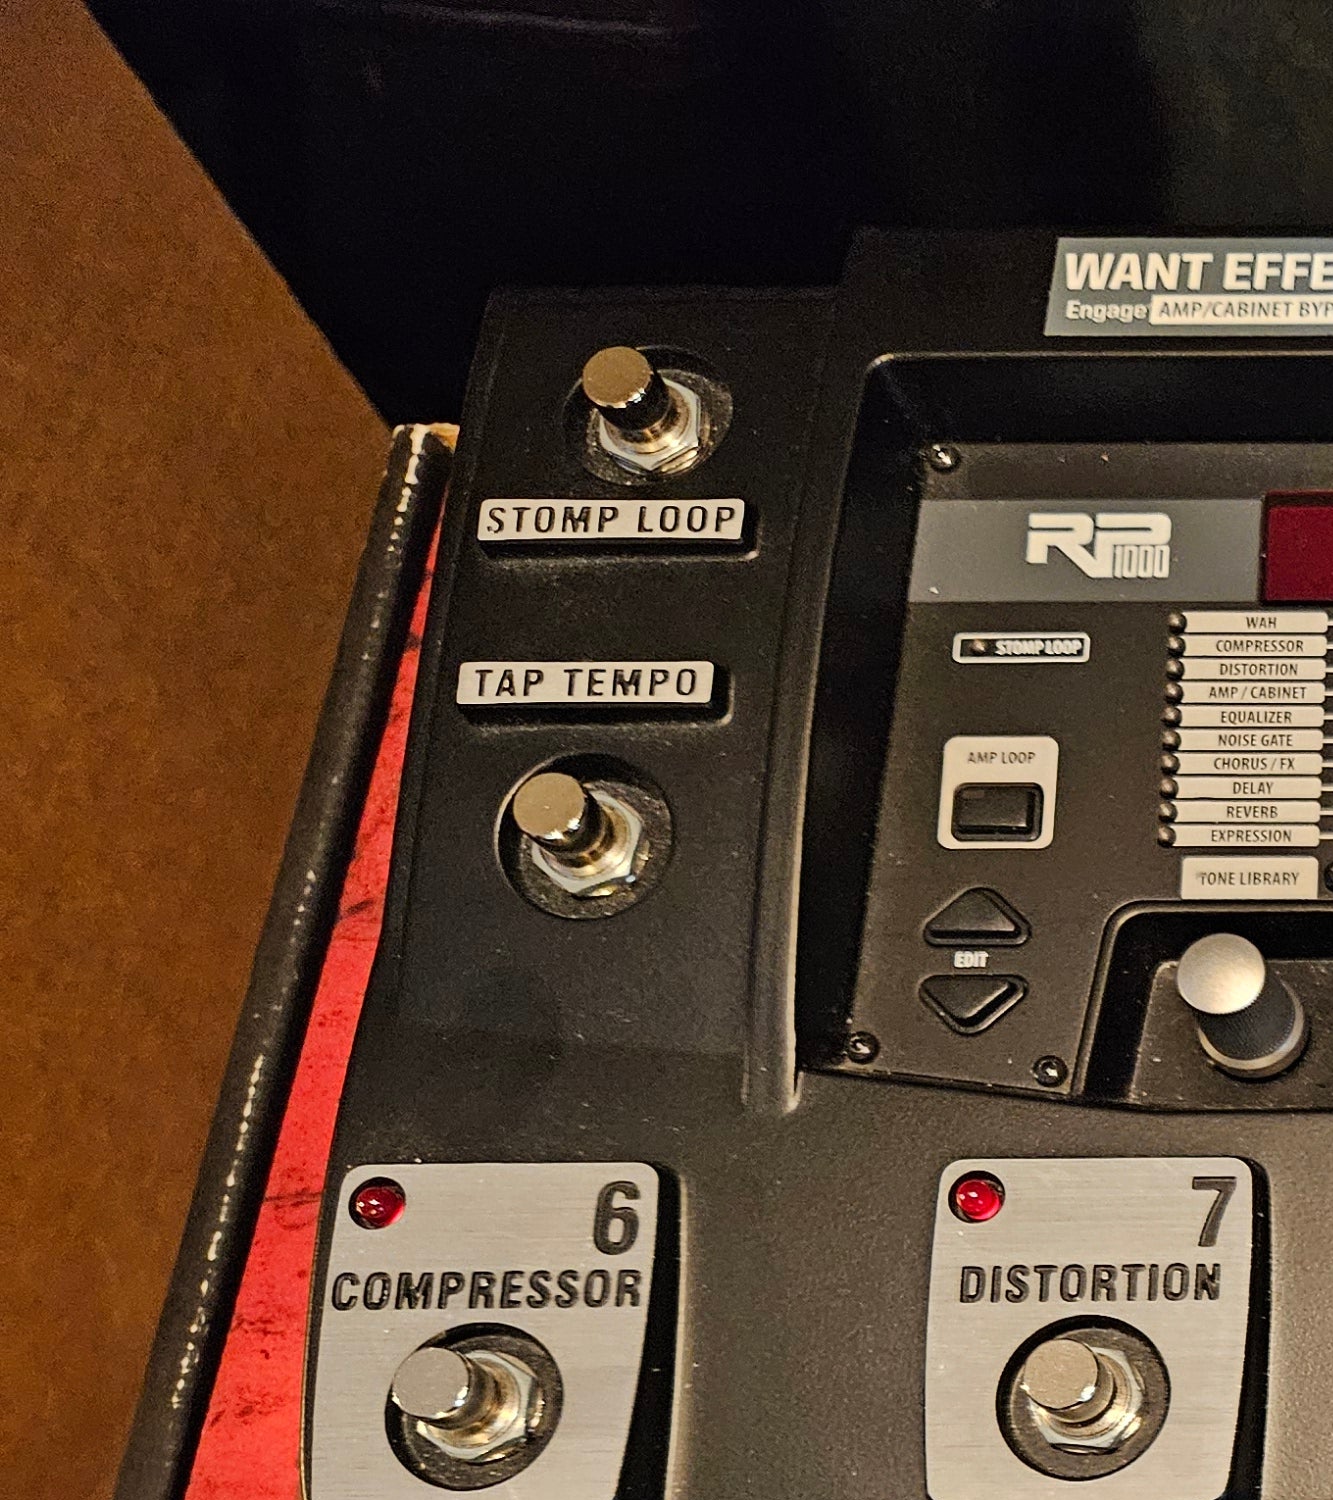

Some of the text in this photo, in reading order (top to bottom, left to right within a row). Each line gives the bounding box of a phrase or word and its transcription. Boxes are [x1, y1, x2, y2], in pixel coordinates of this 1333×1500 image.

[1065, 252, 1214, 291] WANT
[1065, 299, 1148, 323] Engage
[1159, 300, 1294, 319] AMP/CABINET
[486, 506, 736, 534] STOMP LOOP
[1246, 617, 1277, 629] WAH
[994, 639, 1082, 656] STOMP LOOP
[1216, 639, 1304, 652] COMPRESSOR
[1219, 663, 1298, 676] DISTORTION
[475, 668, 698, 697] TAP TEMPO
[1209, 686, 1239, 699] AMP
[1251, 686, 1307, 699] CABINET
[1221, 711, 1292, 725] EQUALIZER
[1218, 734, 1293, 747] NOISE GATE
[967, 752, 1035, 764] AMP LOOP
[1213, 758, 1266, 770] CHORUS
[1279, 758, 1295, 770] FX
[1233, 782, 1274, 795] DELAY
[1226, 806, 1278, 819] REVERB
[1211, 830, 1292, 843] EXPRESSION
[1199, 872, 1299, 886] TONE LIBRARY
[954, 950, 988, 968] EDIT
[592, 1180, 641, 1257] 6
[1191, 1175, 1238, 1249] 7
[331, 1269, 642, 1311] COMPRESSOR
[960, 1263, 1222, 1303] DISTORTION
